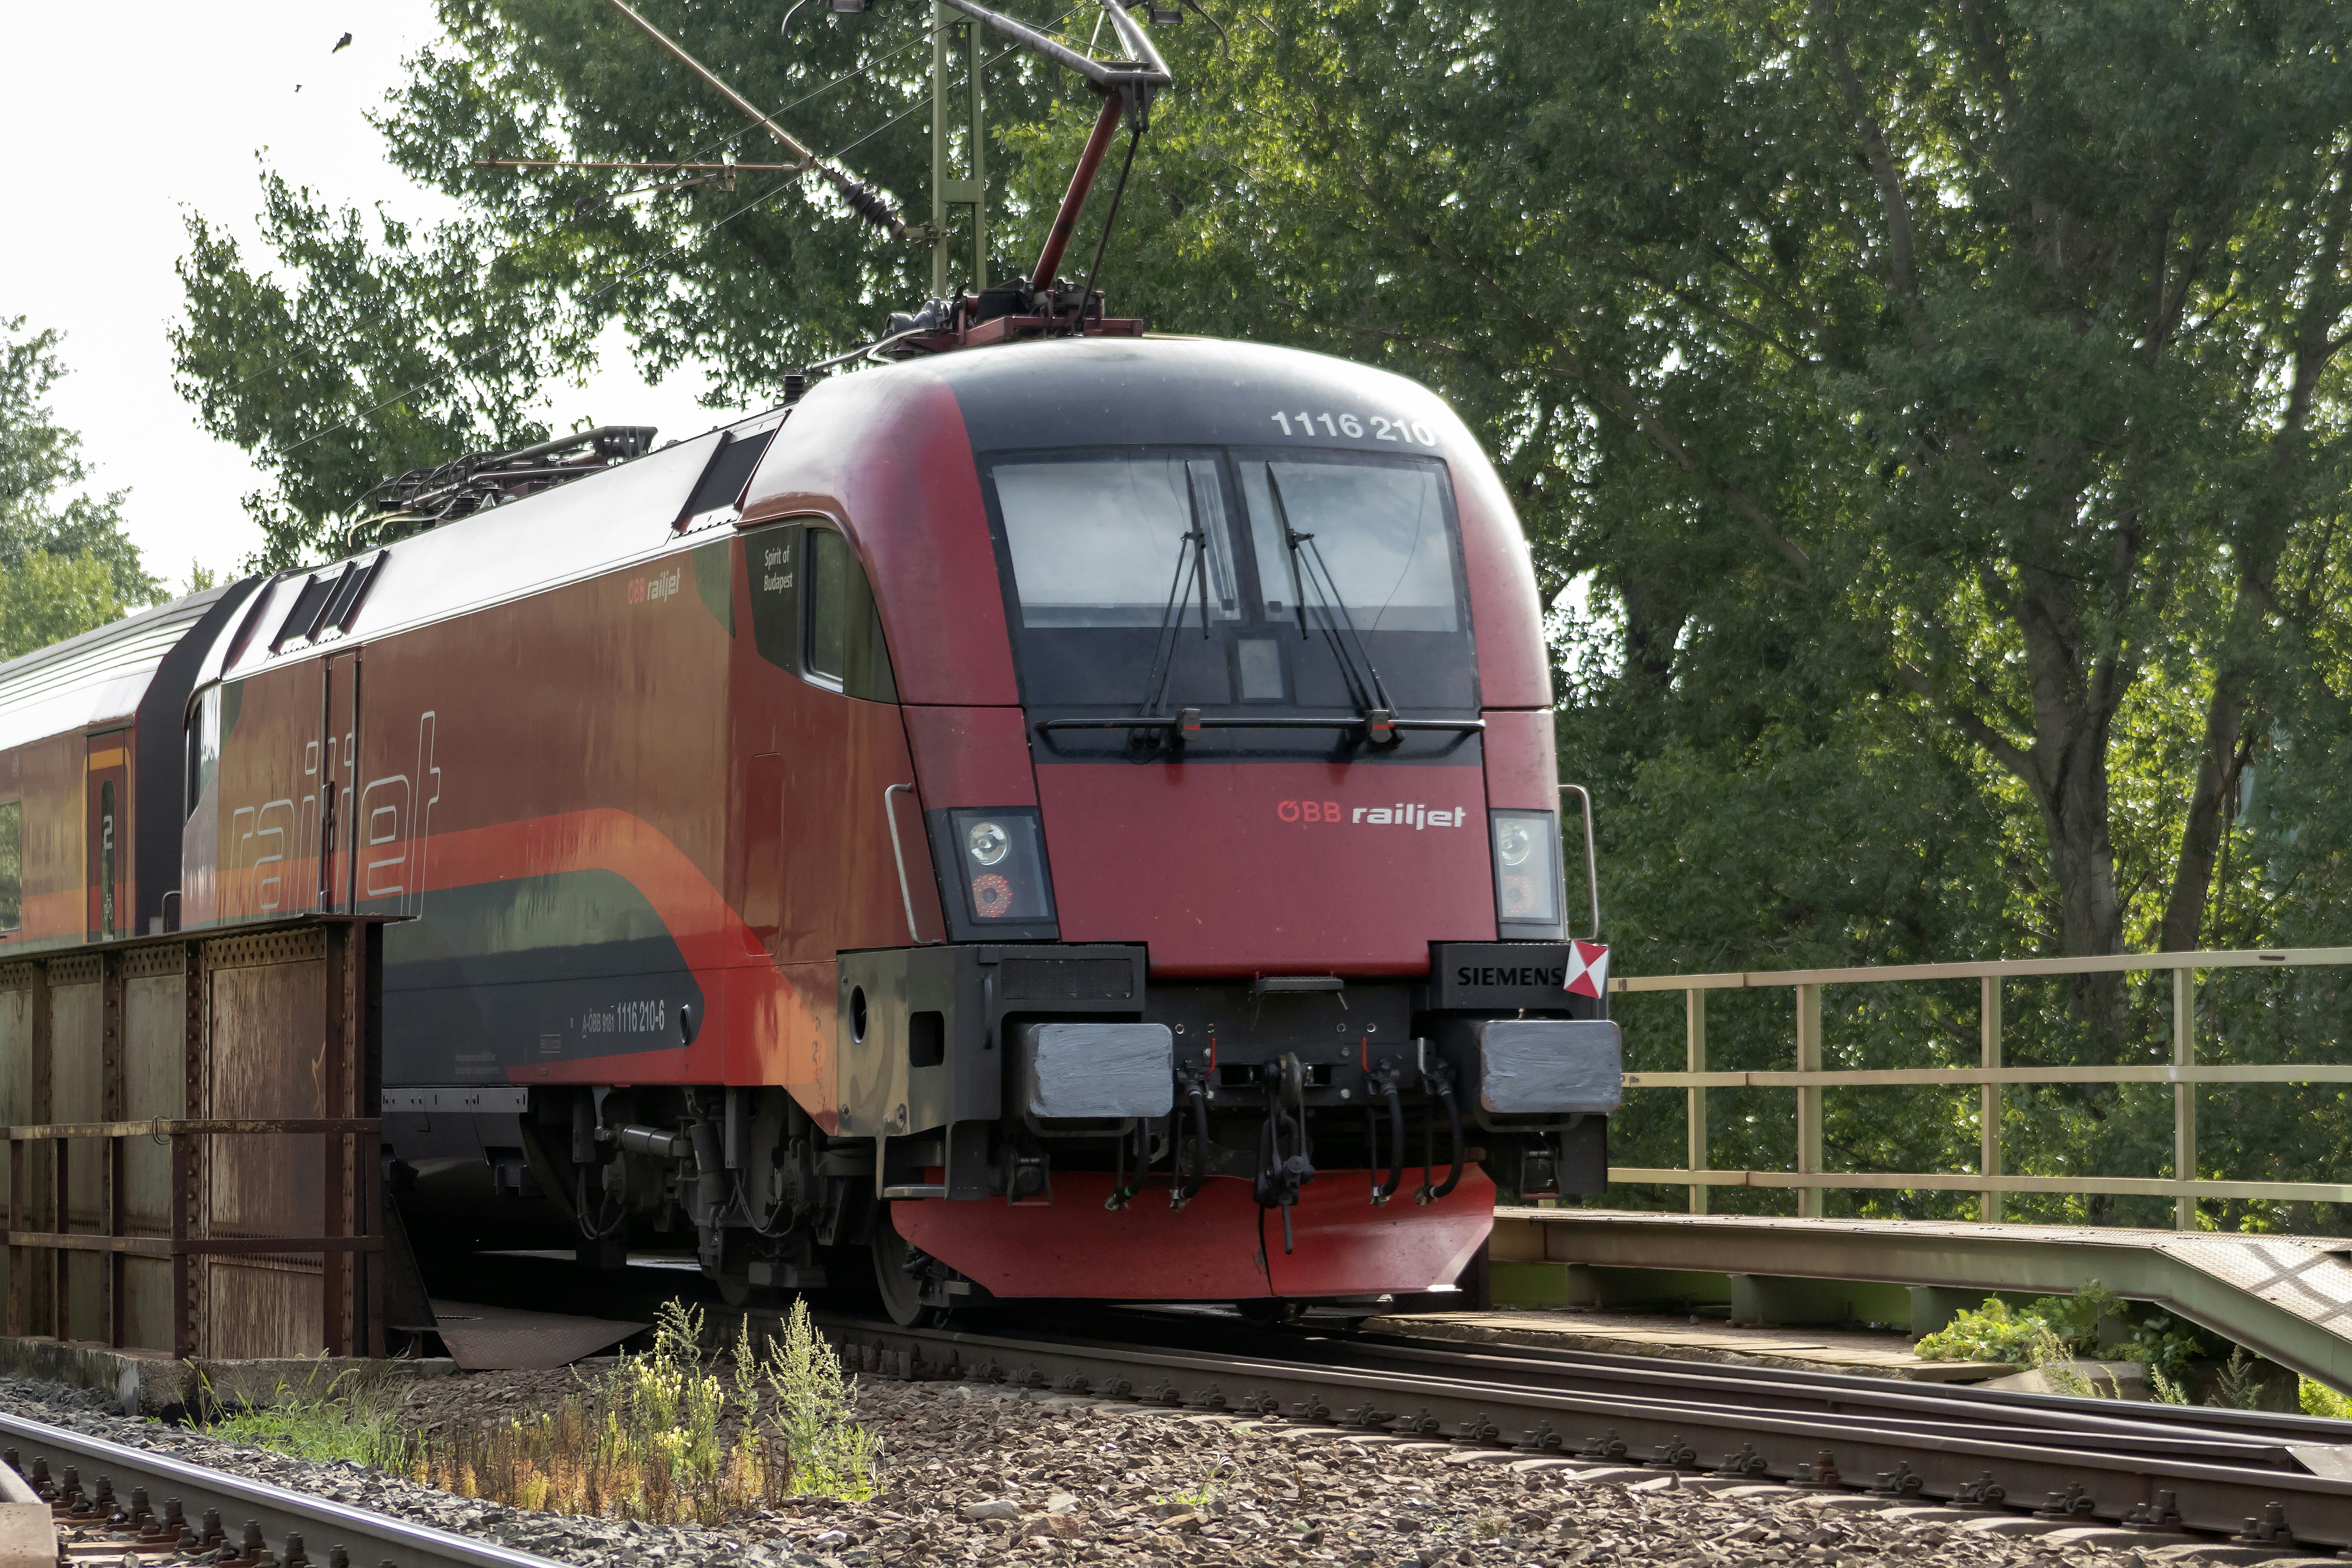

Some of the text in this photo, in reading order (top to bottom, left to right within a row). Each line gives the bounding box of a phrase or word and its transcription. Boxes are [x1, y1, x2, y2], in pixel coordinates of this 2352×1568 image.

[1271, 411, 1436, 447] 1116 210
[764, 545, 789, 571] Spirit of
[647, 567, 681, 603] railjet
[764, 572, 793, 594] Budapest
[1277, 799, 1466, 831] ÖBB railjet
[103, 815, 113, 850] 2
[1457, 967, 1563, 986] SIEMENS
[617, 1001, 637, 1033] 1116
[639, 1000, 665, 1032] 210-6
